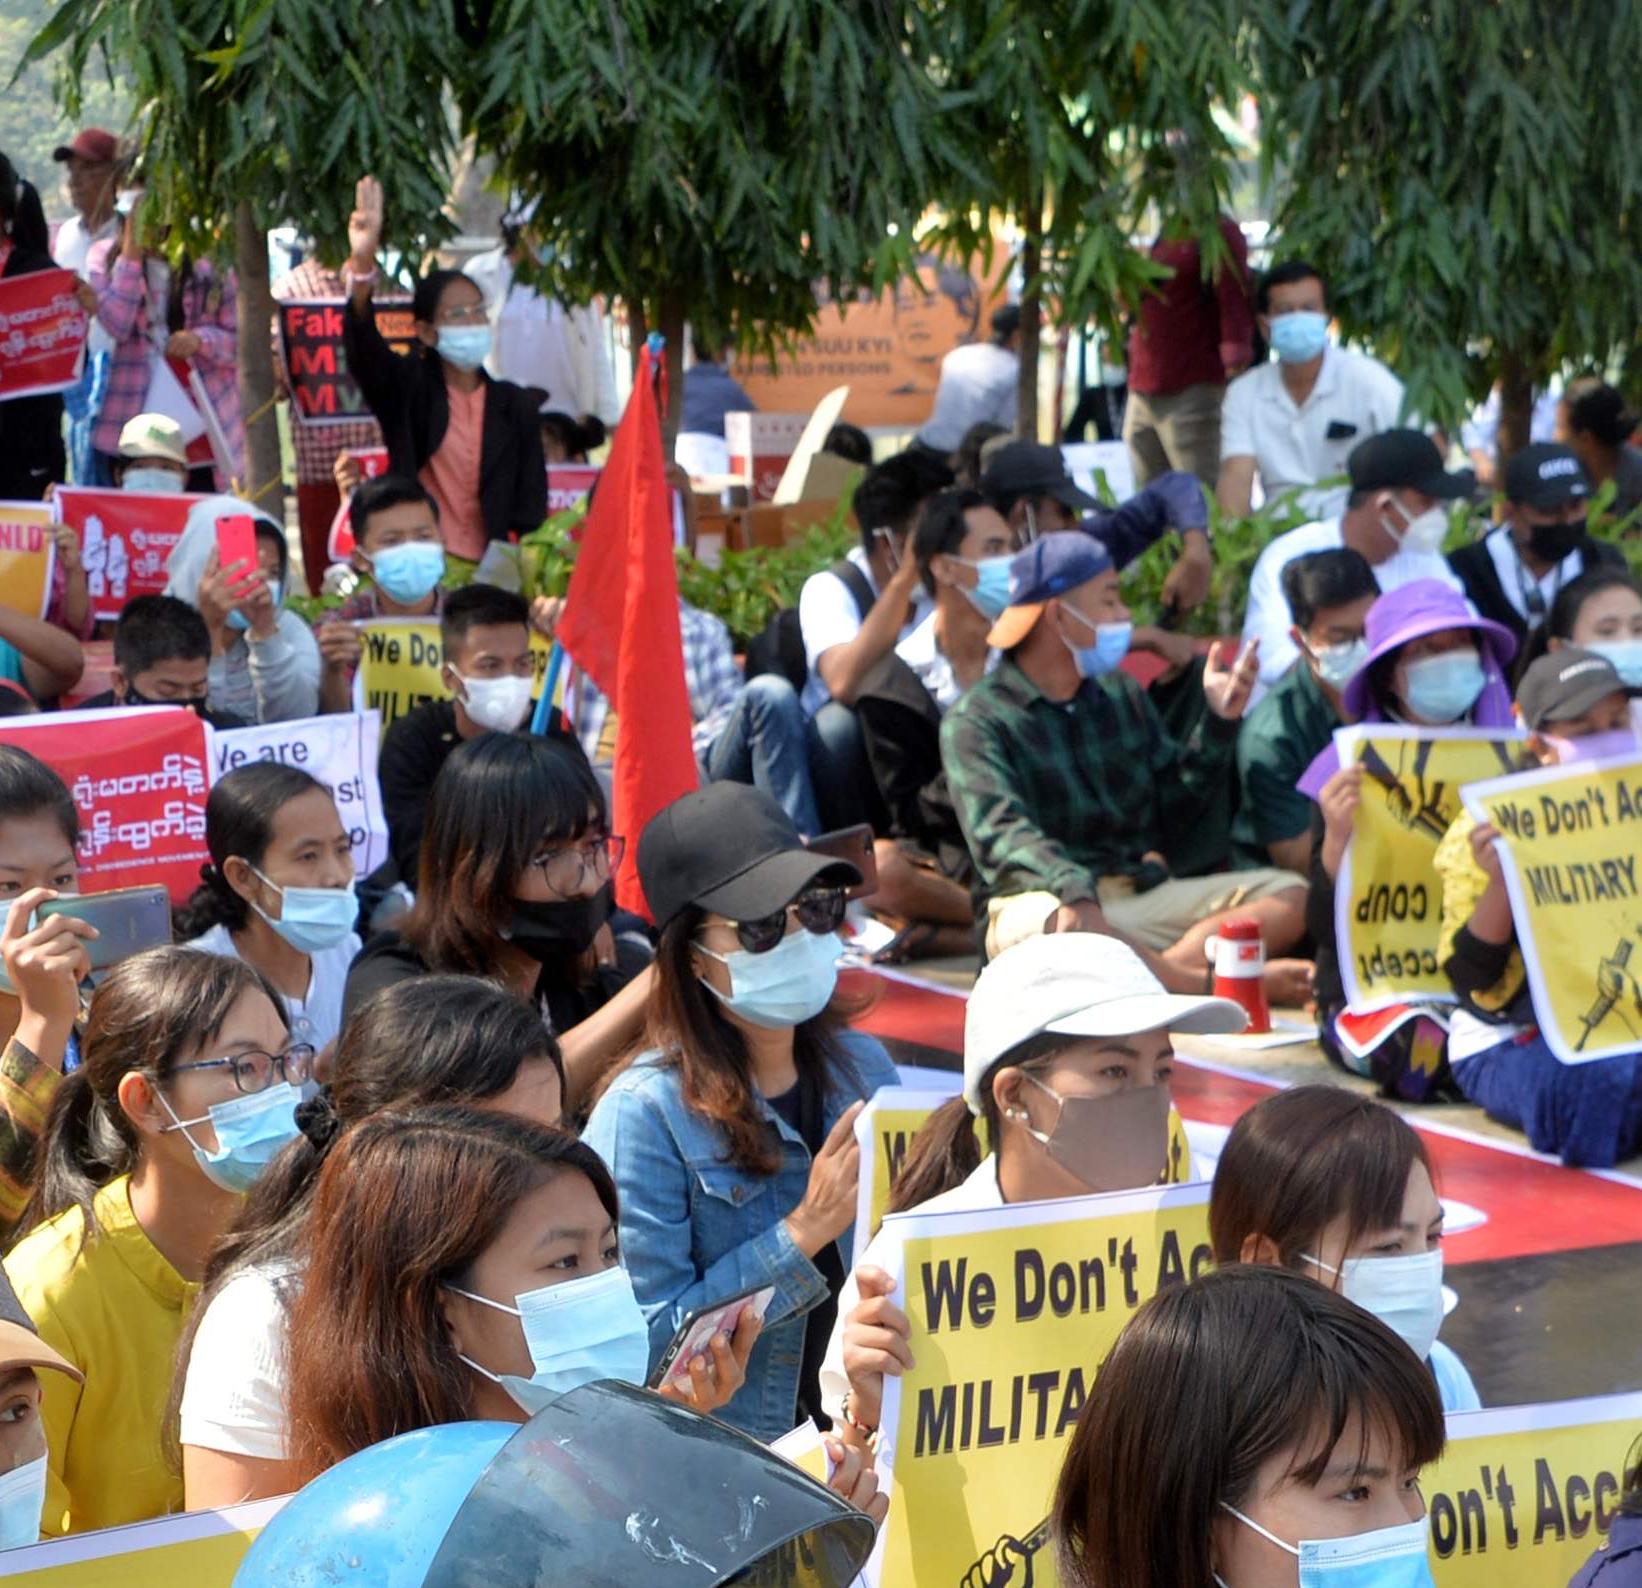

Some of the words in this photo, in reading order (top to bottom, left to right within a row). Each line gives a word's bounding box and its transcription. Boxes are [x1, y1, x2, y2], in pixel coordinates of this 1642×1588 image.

[287, 308, 344, 338] Fak
[367, 631, 401, 665] We
[257, 741, 309, 764] are
[1493, 800, 1537, 845] We
[1541, 783, 1613, 834] Don't
[1523, 854, 1638, 909] MILITARY
[1360, 944, 1440, 988] ccept
[921, 1255, 997, 1335] We
[1013, 1237, 1140, 1324] Don't
[913, 1364, 1092, 1458] MILITA
[1431, 1462, 1521, 1559] on't
[1534, 1456, 1622, 1546] Acc
